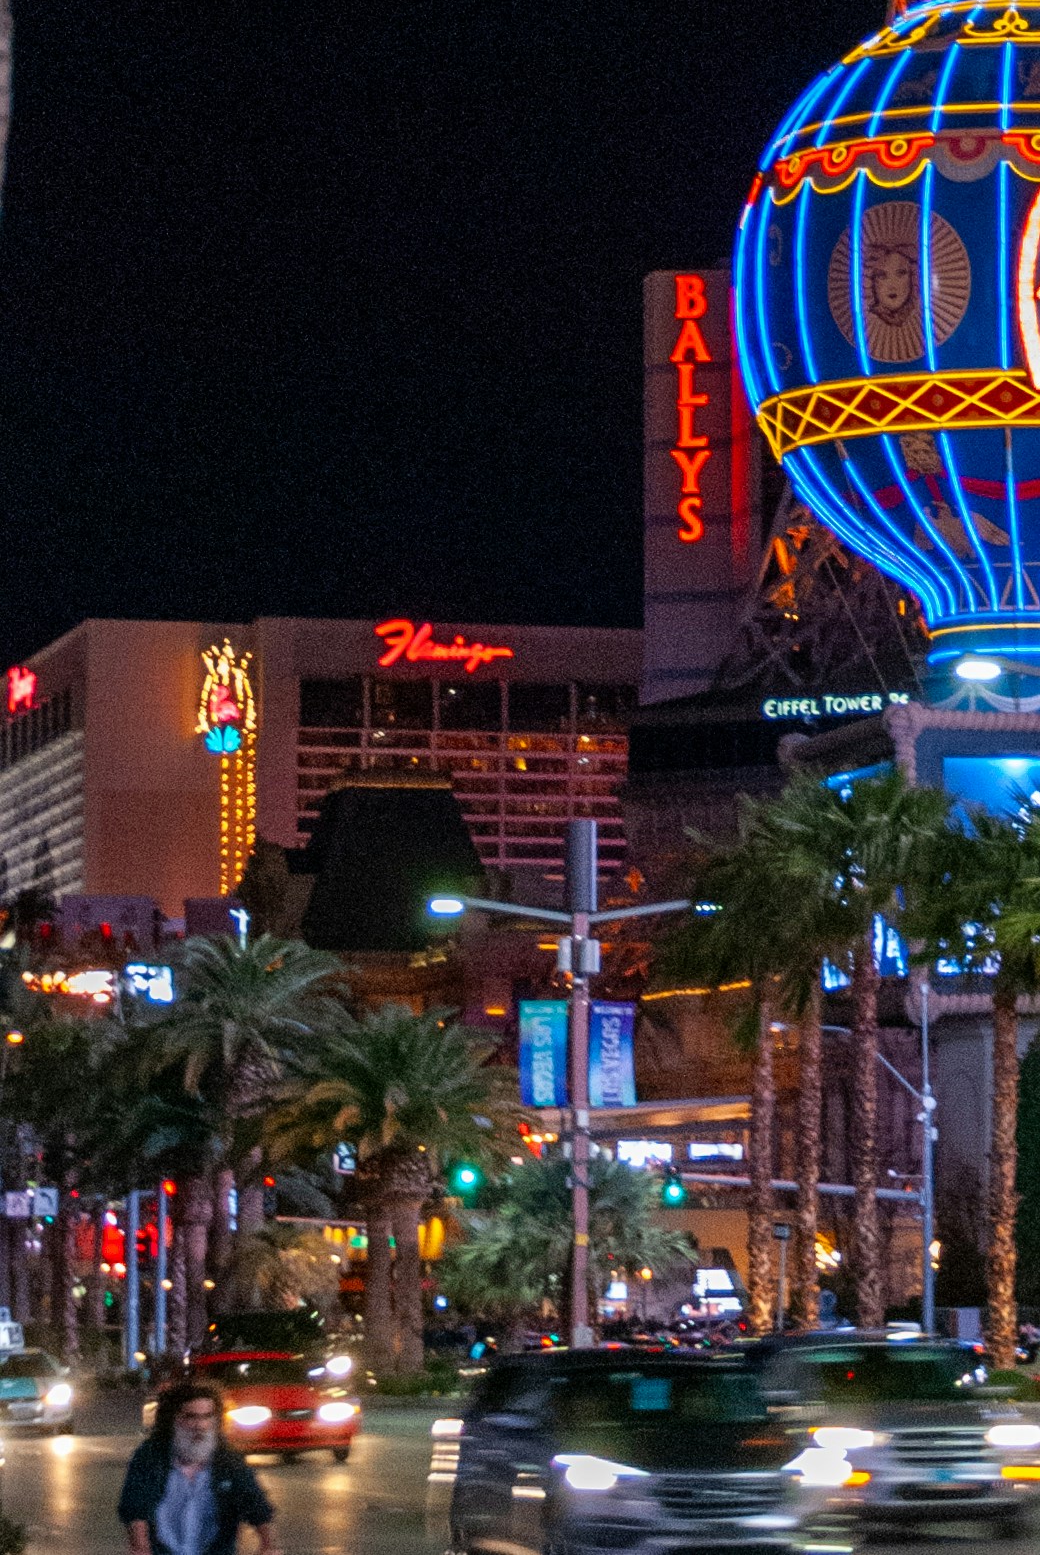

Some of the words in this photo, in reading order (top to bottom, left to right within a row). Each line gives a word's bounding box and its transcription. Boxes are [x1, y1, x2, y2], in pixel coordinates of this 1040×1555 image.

[374, 619, 514, 674] Flamingo
[763, 698, 820, 718] EIFFEL
[822, 694, 883, 714] TOWER
